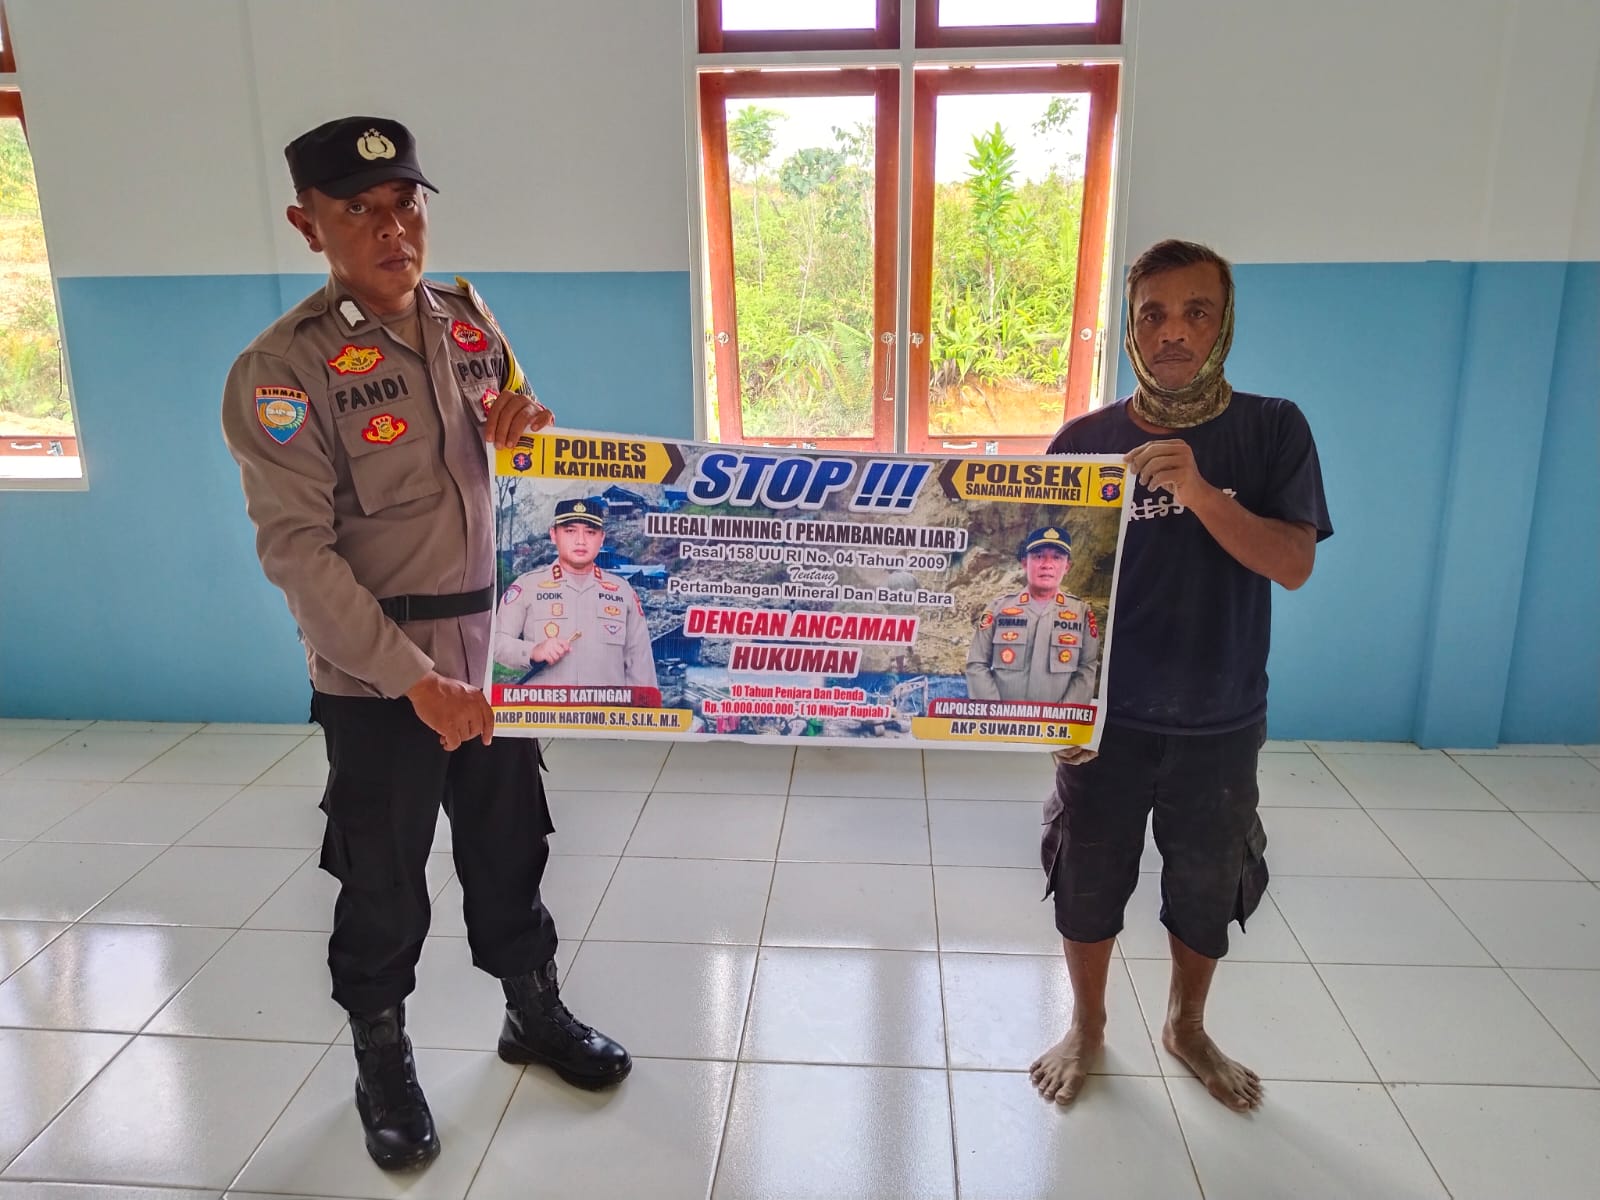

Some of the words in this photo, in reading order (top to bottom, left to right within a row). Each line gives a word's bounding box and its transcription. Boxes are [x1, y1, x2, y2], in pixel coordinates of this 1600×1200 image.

[261, 389, 302, 399] BINMAS
[335, 374, 408, 413] FANDI
[555, 438, 646, 462] POLRES
[554, 461, 646, 479] KATINGAN
[966, 463, 1083, 487] POLSEK
[692, 453, 853, 505] STOP
[856, 462, 929, 508] !!!
[966, 484, 1022, 500] SANAMAN
[1025, 486, 1081, 501] MANTIKEI
[647, 516, 707, 535] ILLEGAL
[711, 518, 781, 538] MINNING
[796, 521, 917, 546] PENAMBANGAN
[920, 528, 955, 548] LIAR
[682, 544, 723, 560] Pasal
[729, 547, 754, 561] 158
[758, 548, 783, 562] UU
[786, 548, 802, 562] RI
[806, 550, 831, 564] No.
[836, 551, 854, 565] 04
[857, 553, 905, 567] Tahun
[909, 555, 945, 570] 2009
[790, 567, 836, 583] Tentang
[537, 592, 563, 601] DODIK
[598, 592, 624, 603] POLRI
[669, 580, 779, 599] Pertambangan
[784, 583, 841, 600] Mineral
[844, 588, 875, 602] Dan
[878, 589, 914, 603] Batu
[917, 591, 953, 605] Bara
[687, 609, 787, 637] DENGAN
[790, 613, 916, 643] ANCAMAN
[1054, 620, 1082, 631] POLRI
[731, 646, 859, 675] HUKUMAN
[503, 687, 567, 703] KAPOLRES
[570, 688, 632, 703] KATINGAN
[731, 685, 742, 697] 10
[743, 685, 772, 698] Tahun
[774, 686, 811, 701] Penjara
[813, 688, 831, 700] Dan
[833, 688, 864, 701] Denda
[704, 701, 719, 716] Rp.
[806, 704, 817, 716] 10
[819, 704, 849, 718] Milyar
[851, 705, 883, 718] Rupiah
[935, 701, 988, 717] KAPOLSEK
[990, 703, 1040, 719] SANAMAN
[1043, 706, 1093, 722] MANTIKEI
[495, 711, 523, 724] AKBP
[525, 711, 557, 725] DODIK
[559, 712, 607, 727] HARTONO,
[609, 713, 630, 727] S.H.,
[632, 713, 657, 727] S.I.K.,
[659, 714, 681, 728] M.H.
[950, 721, 977, 735] AKP
[979, 722, 1043, 738] SUWARDI,
[1046, 725, 1071, 739] S.H.
